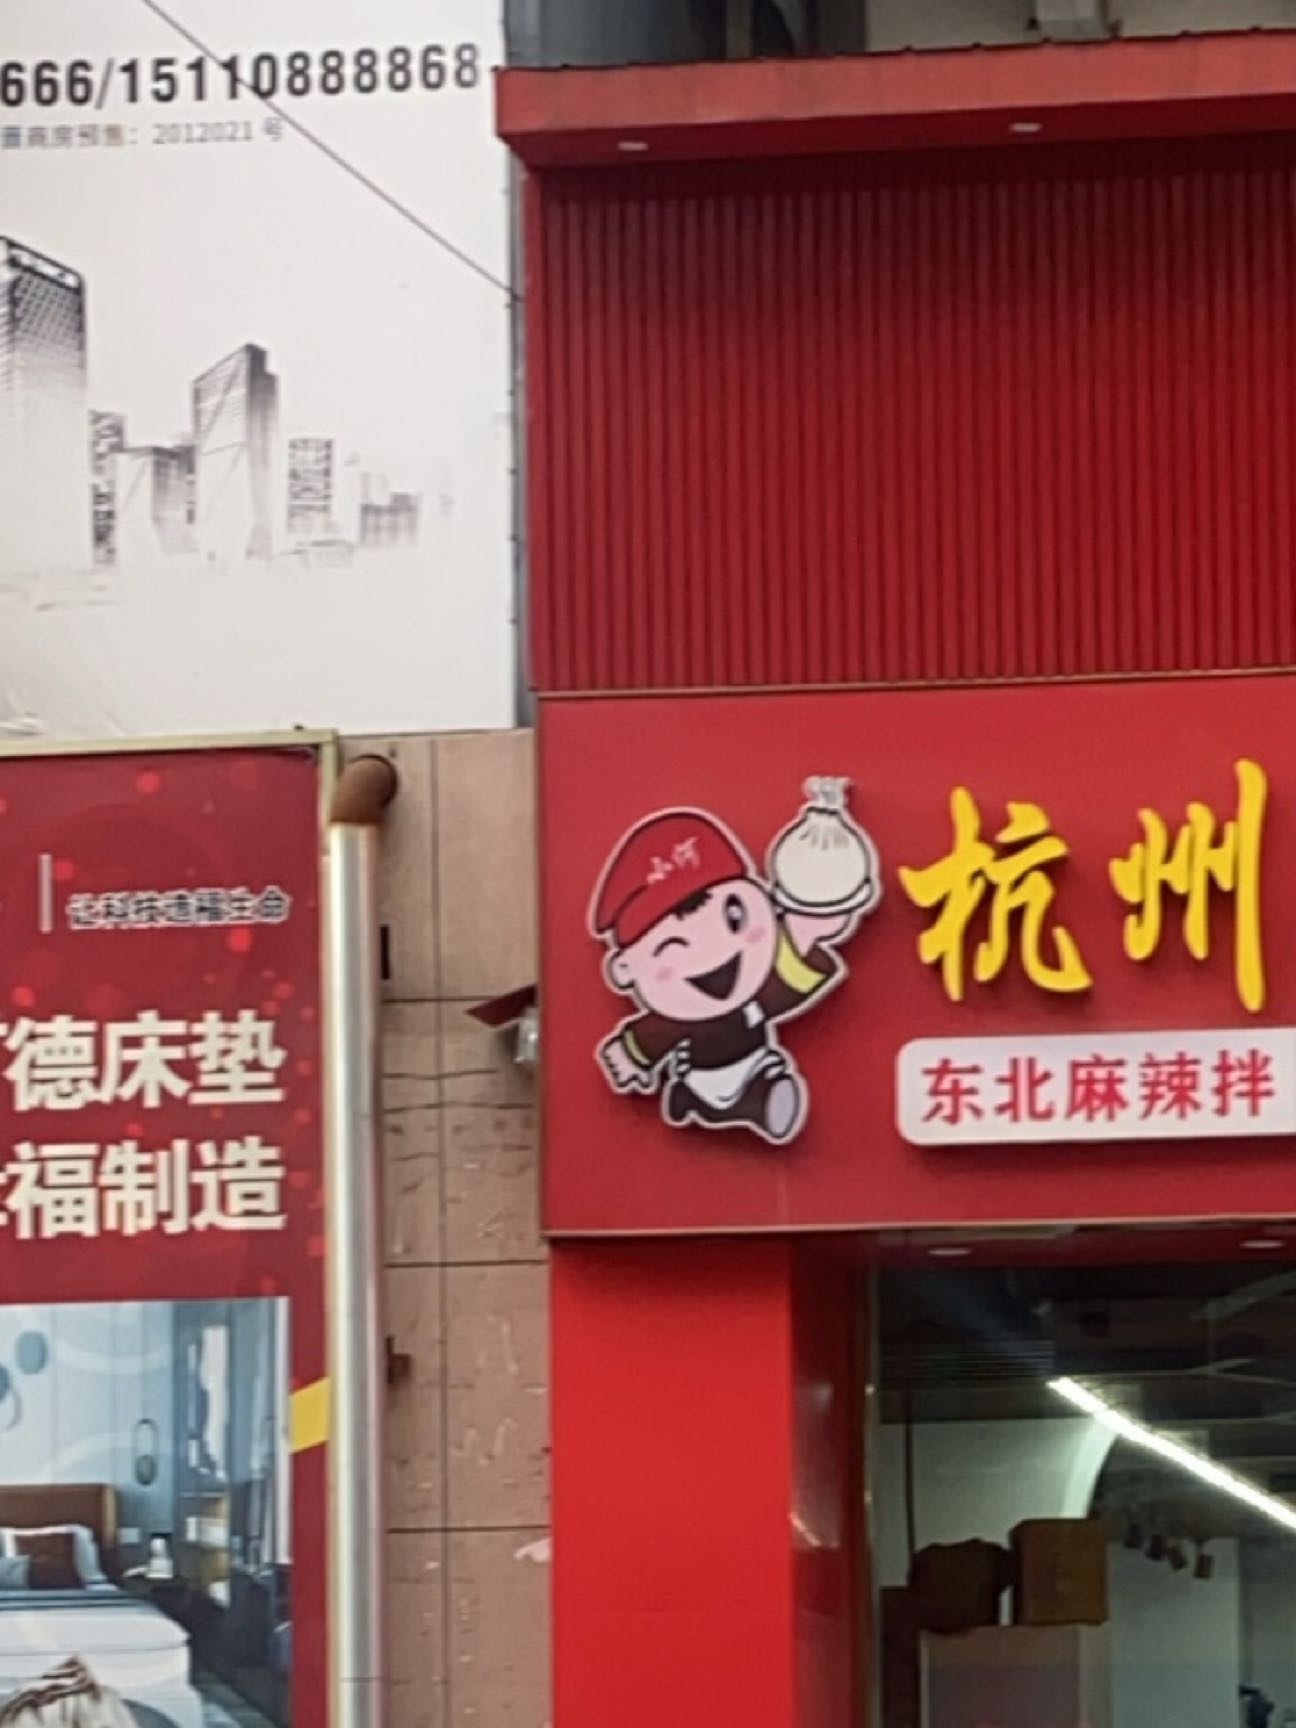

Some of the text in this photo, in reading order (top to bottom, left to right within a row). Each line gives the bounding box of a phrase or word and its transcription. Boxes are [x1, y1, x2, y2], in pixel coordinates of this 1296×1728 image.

[0, 43, 481, 110] 666/15110888868
[0, 1008, 287, 1111] 德床垫
[921, 1047, 1275, 1127] 东北麻辣拌
[0, 1135, 287, 1240] 福制造
